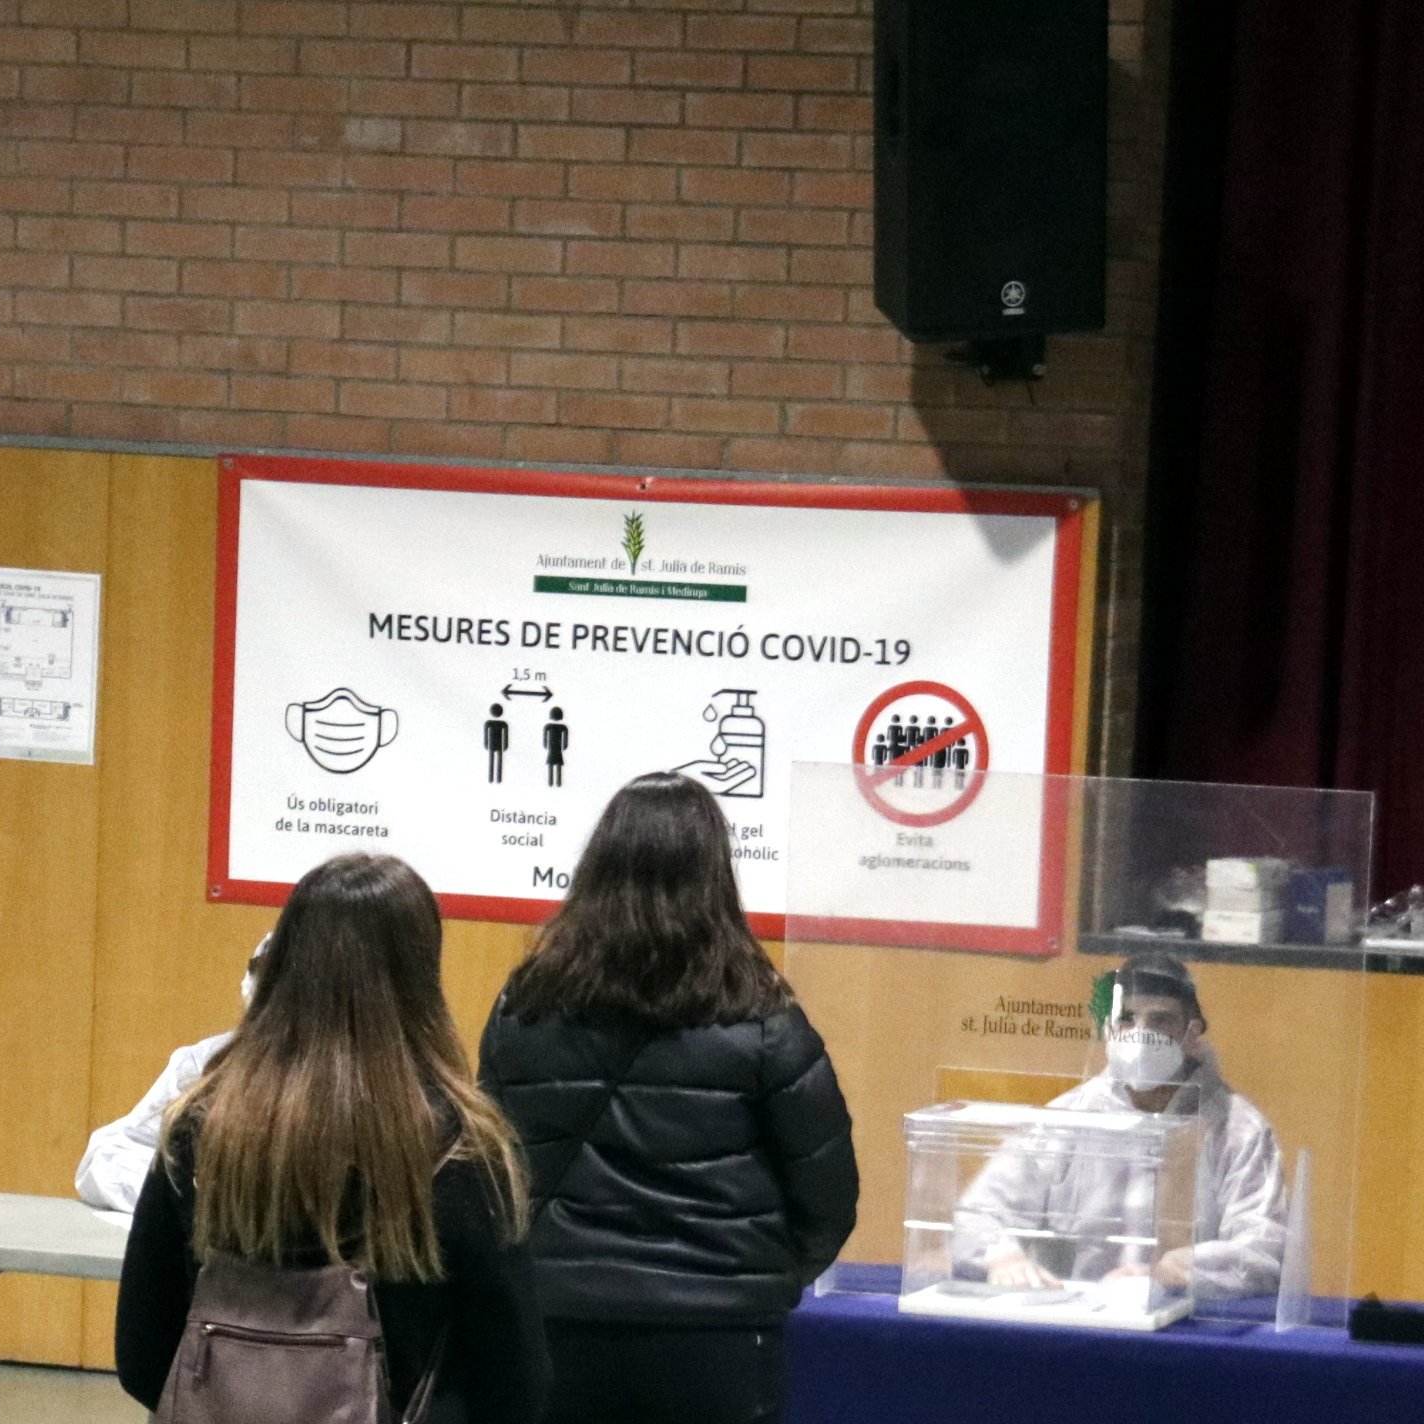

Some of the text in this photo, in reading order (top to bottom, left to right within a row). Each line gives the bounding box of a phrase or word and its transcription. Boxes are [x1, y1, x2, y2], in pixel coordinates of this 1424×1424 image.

[536, 553, 607, 569] Ajuntament
[611, 557, 625, 570] de
[640, 559, 655, 571] st.
[690, 561, 705, 574] de
[708, 561, 746, 576] Ramis
[616, 583, 627, 593] de
[629, 584, 660, 595] Ramis
[368, 612, 911, 665] MESURES DE PREVENCIÓ COVID-19
[512, 668, 546, 682] 1,5 m
[287, 792, 378, 816] Ús obligatori
[490, 808, 557, 826] Distància
[275, 817, 389, 837] de la mascareta
[741, 823, 763, 840] gel
[501, 832, 543, 847] social
[896, 831, 933, 847] Evita
[858, 853, 971, 871] aglomeracions
[994, 996, 1083, 1019] Ajuntament
[961, 1016, 977, 1032] st.
[1021, 1018, 1040, 1036] de
[1044, 1019, 1091, 1040] Ramis
